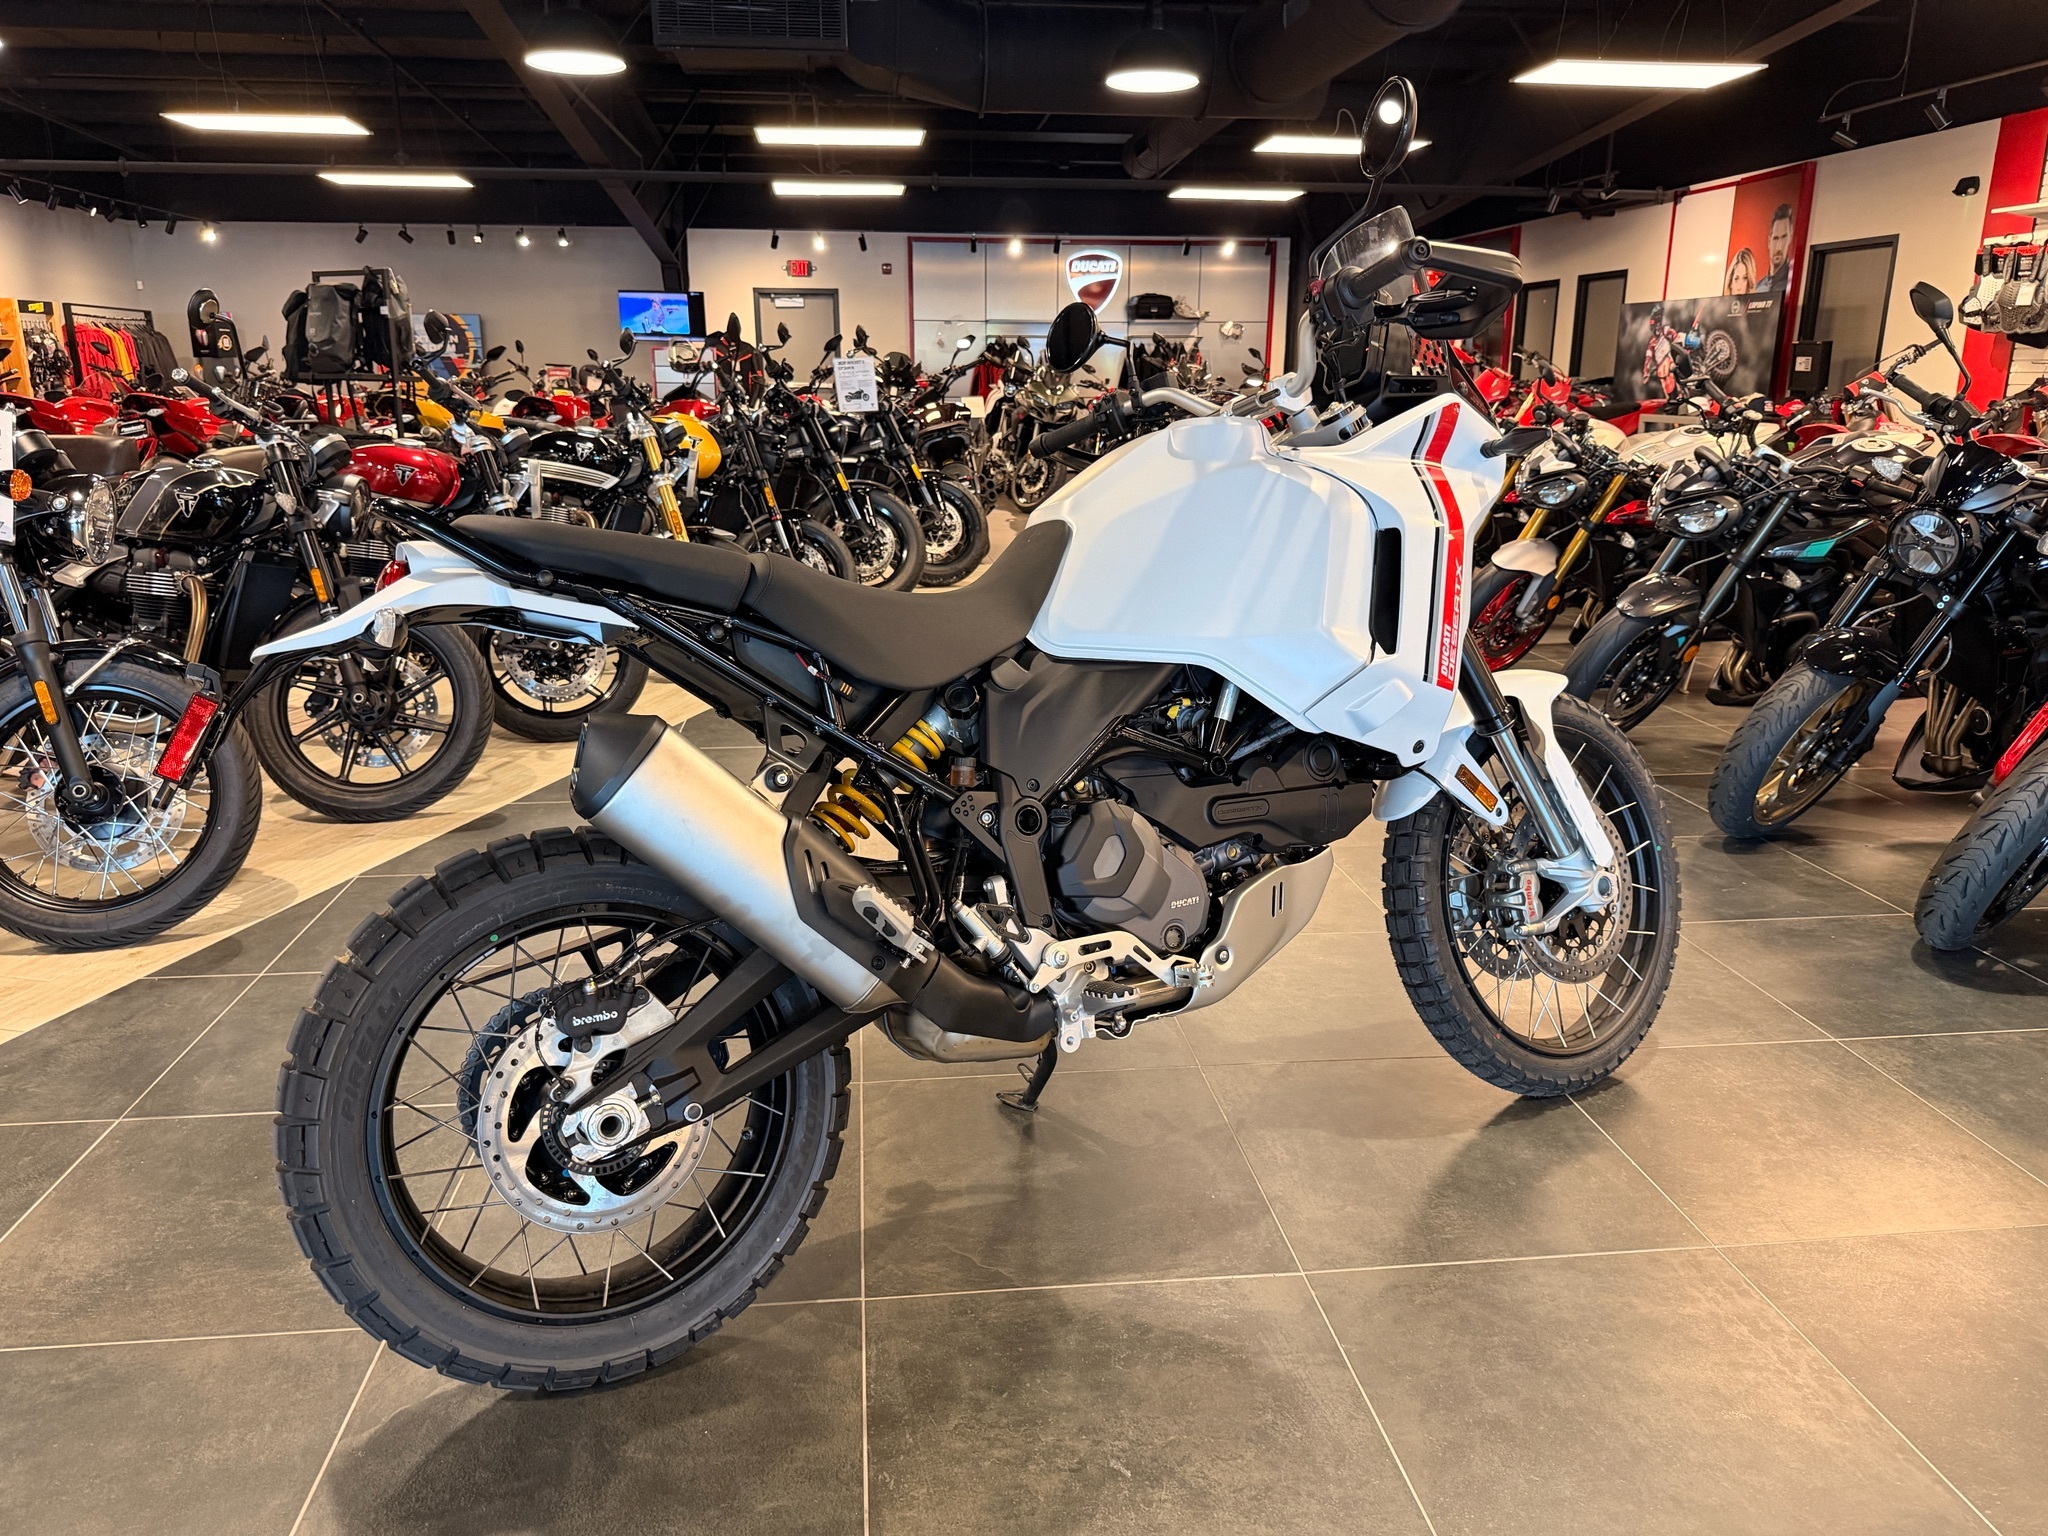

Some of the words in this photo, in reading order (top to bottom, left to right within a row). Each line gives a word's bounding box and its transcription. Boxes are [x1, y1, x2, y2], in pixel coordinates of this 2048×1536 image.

[790, 260, 809, 276] EXIT
[1070, 259, 1117, 273] DUCATI
[1447, 556, 1464, 682] DESERTX
[1440, 623, 1452, 678] DUCATI
[1170, 896, 1200, 909] DUCATI
[1525, 879, 1536, 918] brembo
[572, 1010, 619, 1027] brembo
[341, 985, 402, 1123] PIRELLI
